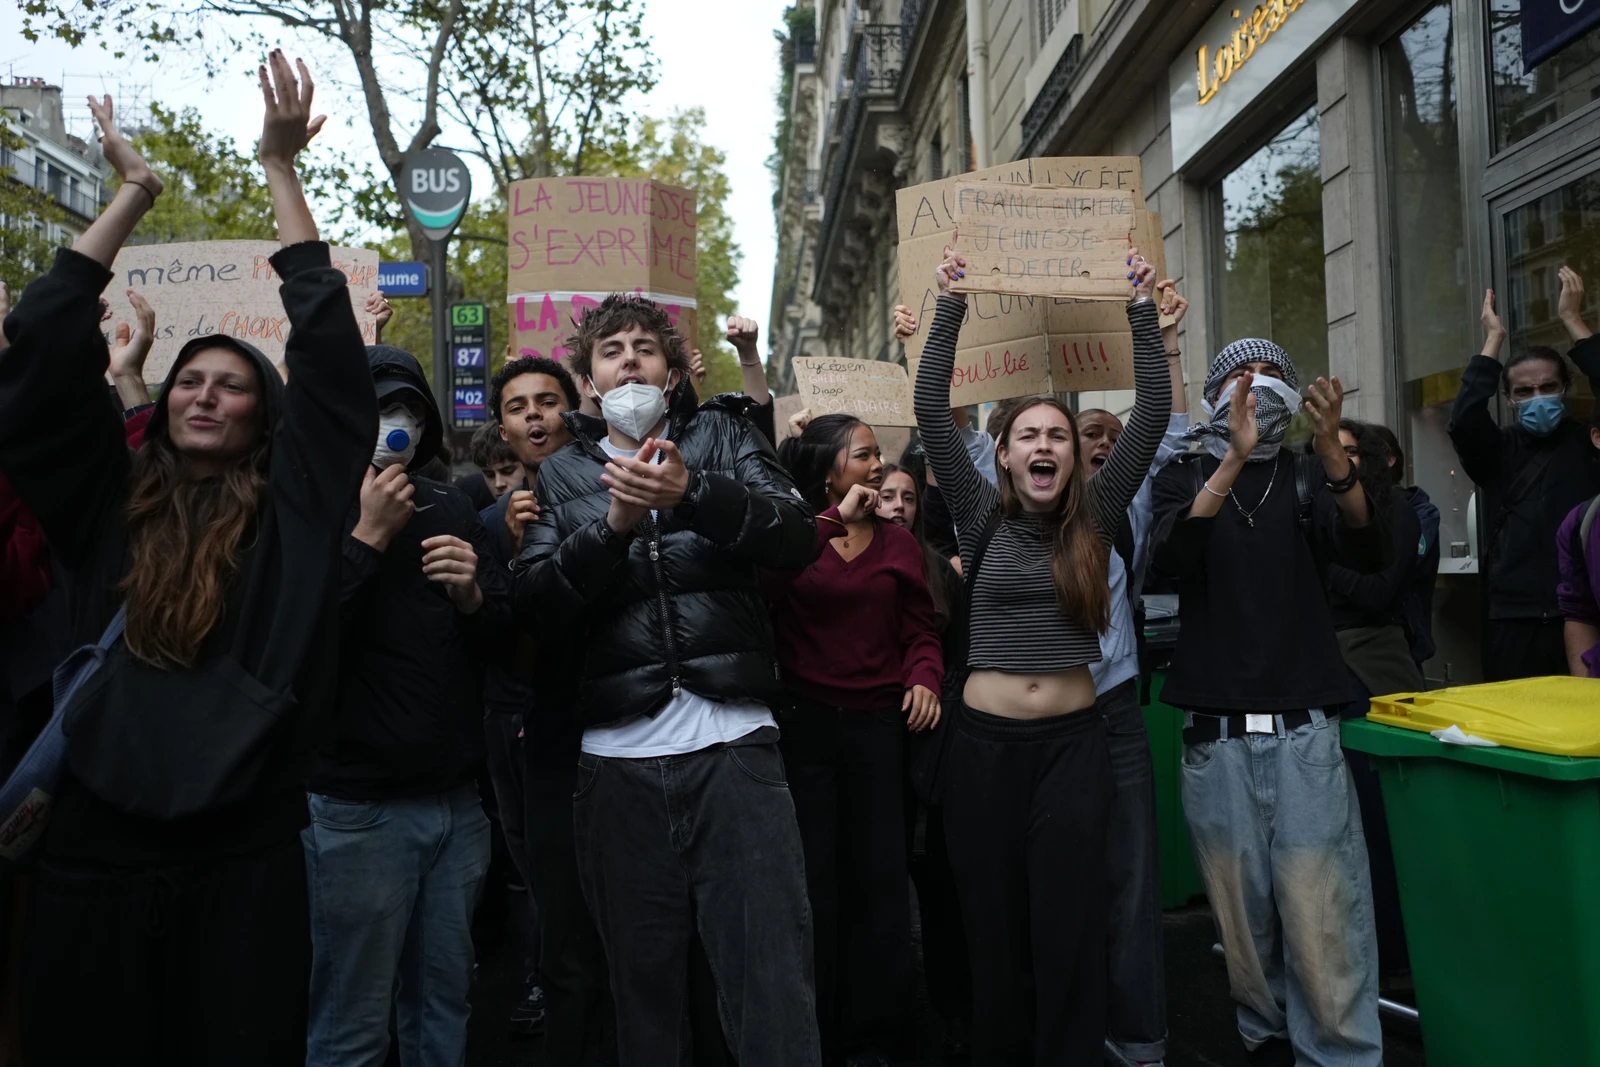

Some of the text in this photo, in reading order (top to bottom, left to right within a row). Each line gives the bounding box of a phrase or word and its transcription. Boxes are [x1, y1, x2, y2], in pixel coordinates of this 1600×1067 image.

[1197, 0, 1307, 106] Loisea
[411, 168, 460, 194] BUS
[514, 181, 697, 229] LA JEUNESSE
[958, 187, 1049, 222] FRANCE
[510, 222, 694, 281] S'EXPRIME
[973, 223, 1096, 253] JEUNESSE
[127, 259, 241, 286] même
[1006, 257, 1083, 279] DETER
[187, 314, 214, 337] de
[219, 311, 287, 343] CHOIX
[457, 307, 479, 323] 63
[516, 293, 563, 333] LA
[457, 347, 481, 366] 87
[950, 351, 1031, 389] oublié
[812, 385, 844, 397] Diago
[817, 399, 902, 414] SOLIDAIRE
